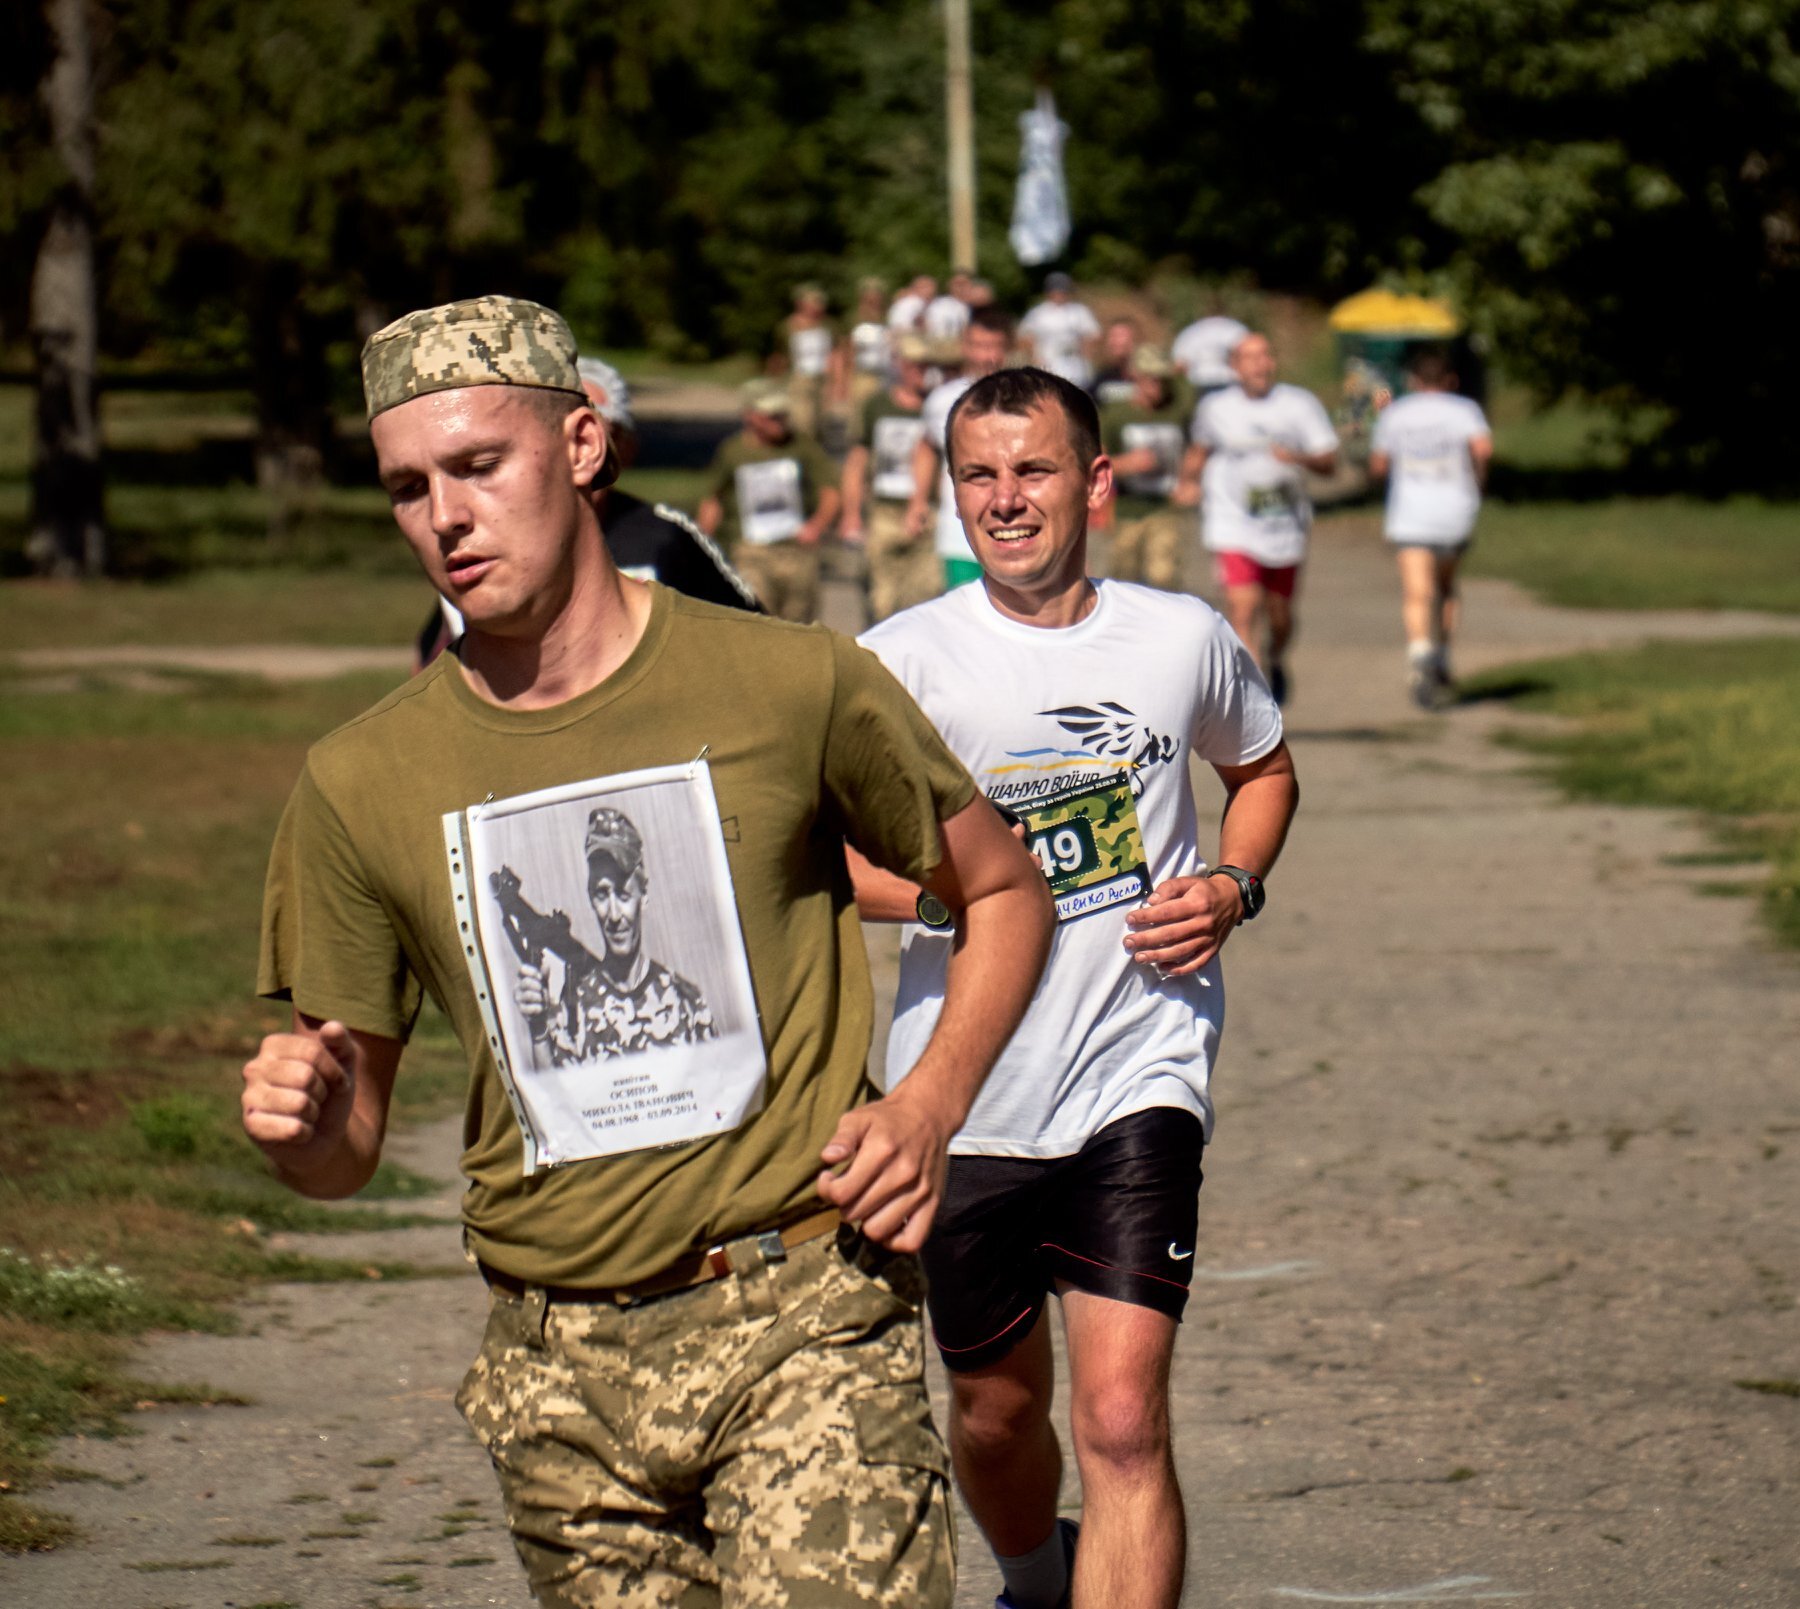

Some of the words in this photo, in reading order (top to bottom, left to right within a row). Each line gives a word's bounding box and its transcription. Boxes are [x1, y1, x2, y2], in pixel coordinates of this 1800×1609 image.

[986, 778, 1050, 799] ШАНУЮ
[1031, 830, 1083, 878] 49
[581, 1103, 631, 1119] МИКОЛА
[633, 1089, 695, 1110] ІВАНОВИЧ
[610, 1083, 659, 1101] ОСИПОВ
